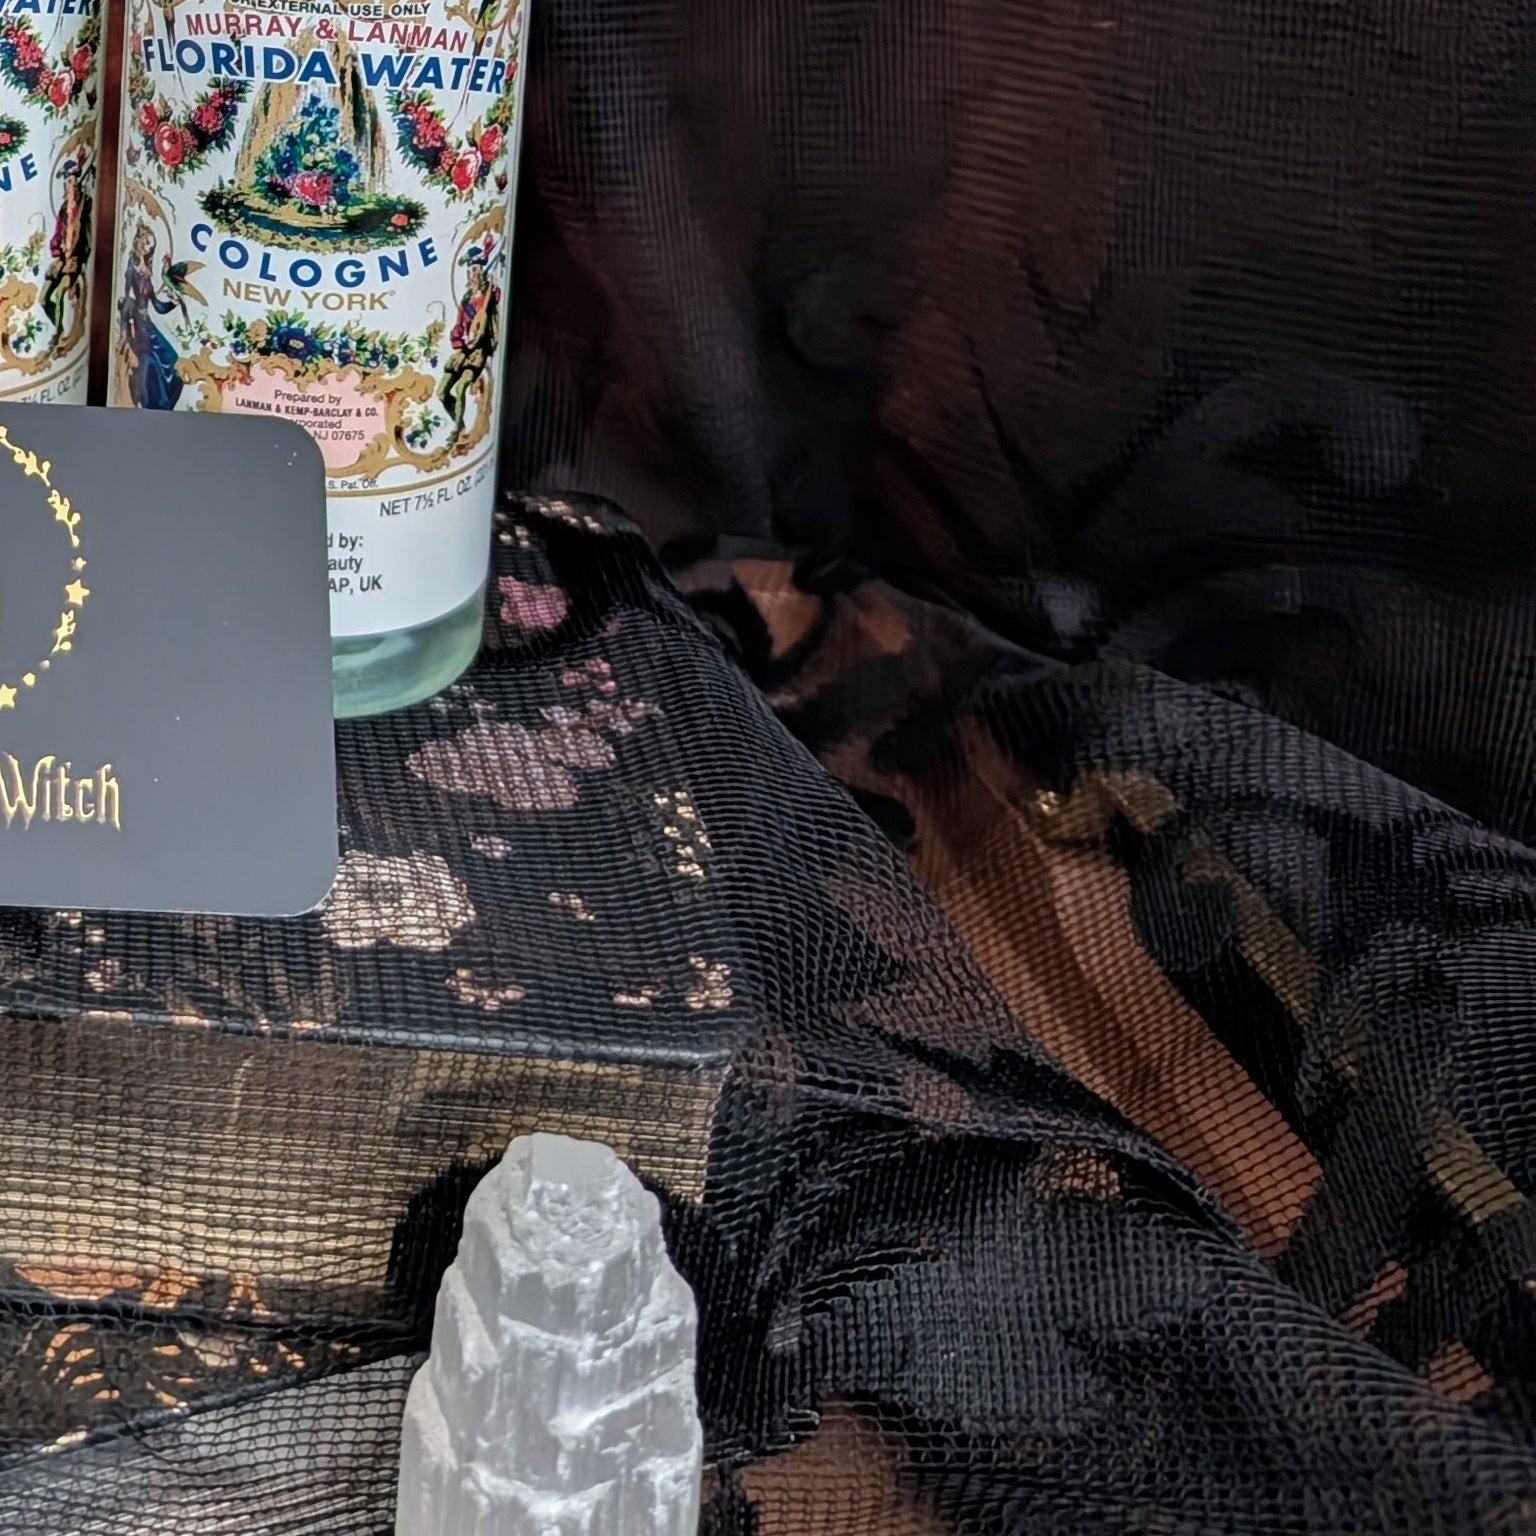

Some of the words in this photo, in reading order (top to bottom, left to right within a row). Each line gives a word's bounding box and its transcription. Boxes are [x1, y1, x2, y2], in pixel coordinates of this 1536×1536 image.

[350, 3, 383, 17] USE
[392, 2, 431, 16] ONLY
[186, 13, 300, 38] MURRAY
[316, 19, 338, 40] &
[348, 20, 469, 53] LANMAN
[143, 37, 337, 85] FLORIDA
[362, 53, 505, 94] WATER
[191, 223, 438, 288] COLOGNE
[222, 277, 291, 307] NEW
[303, 291, 390, 312] YORK
[235, 397, 272, 411] LANMAN
[274, 389, 325, 404] Prepared
[329, 393, 342, 405] by
[331, 430, 365, 441] 07675
[379, 497, 412, 517] NET
[338, 533, 364, 551] by:
[328, 556, 364, 574] auty
[328, 576, 354, 596] AP,
[359, 573, 383, 592] UK
